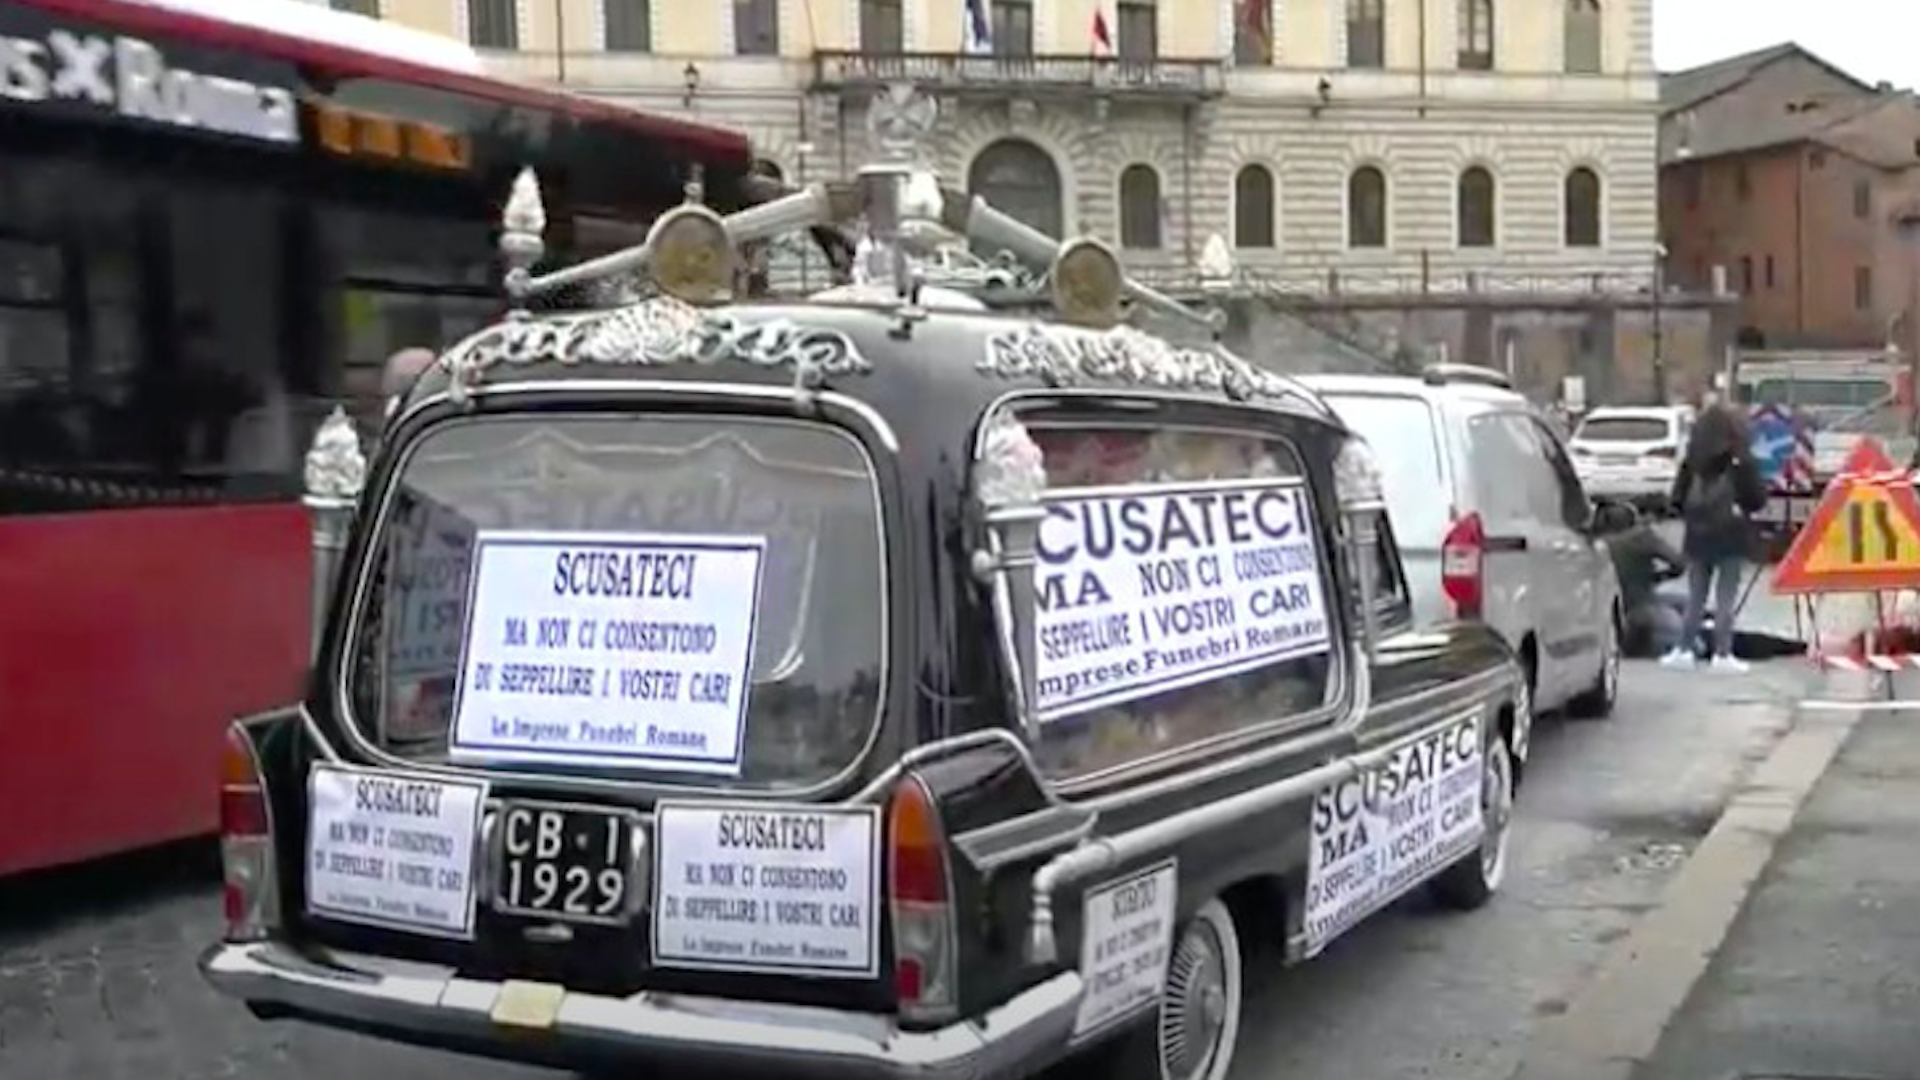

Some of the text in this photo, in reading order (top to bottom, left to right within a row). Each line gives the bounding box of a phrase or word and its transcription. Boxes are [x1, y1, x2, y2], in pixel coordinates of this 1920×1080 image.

[1036, 489, 1306, 564] CUSATECI
[554, 550, 697, 599] SCUSATECI
[1138, 555, 1191, 597] NON
[1196, 553, 1222, 587] CI
[503, 617, 718, 654] MA NON CI CONSENTONO
[1040, 582, 1312, 661] SEPPELLIRE I VOSTRI CARI
[474, 662, 732, 707] DI SEPPELLIRE I VOSTRI CARI
[1037, 659, 1139, 698] mprese
[1141, 635, 1240, 674] Funebri
[512, 718, 570, 743] Imprese
[580, 721, 638, 746] Funebri
[647, 725, 707, 751] Romane
[356, 777, 442, 818] SCUSATECI
[505, 809, 563, 859] CB
[718, 814, 826, 852] SCUSATECI
[1320, 820, 1368, 870] MA
[508, 859, 624, 915] 1929
[710, 862, 734, 886] NON
[829, 904, 861, 928] CARI
